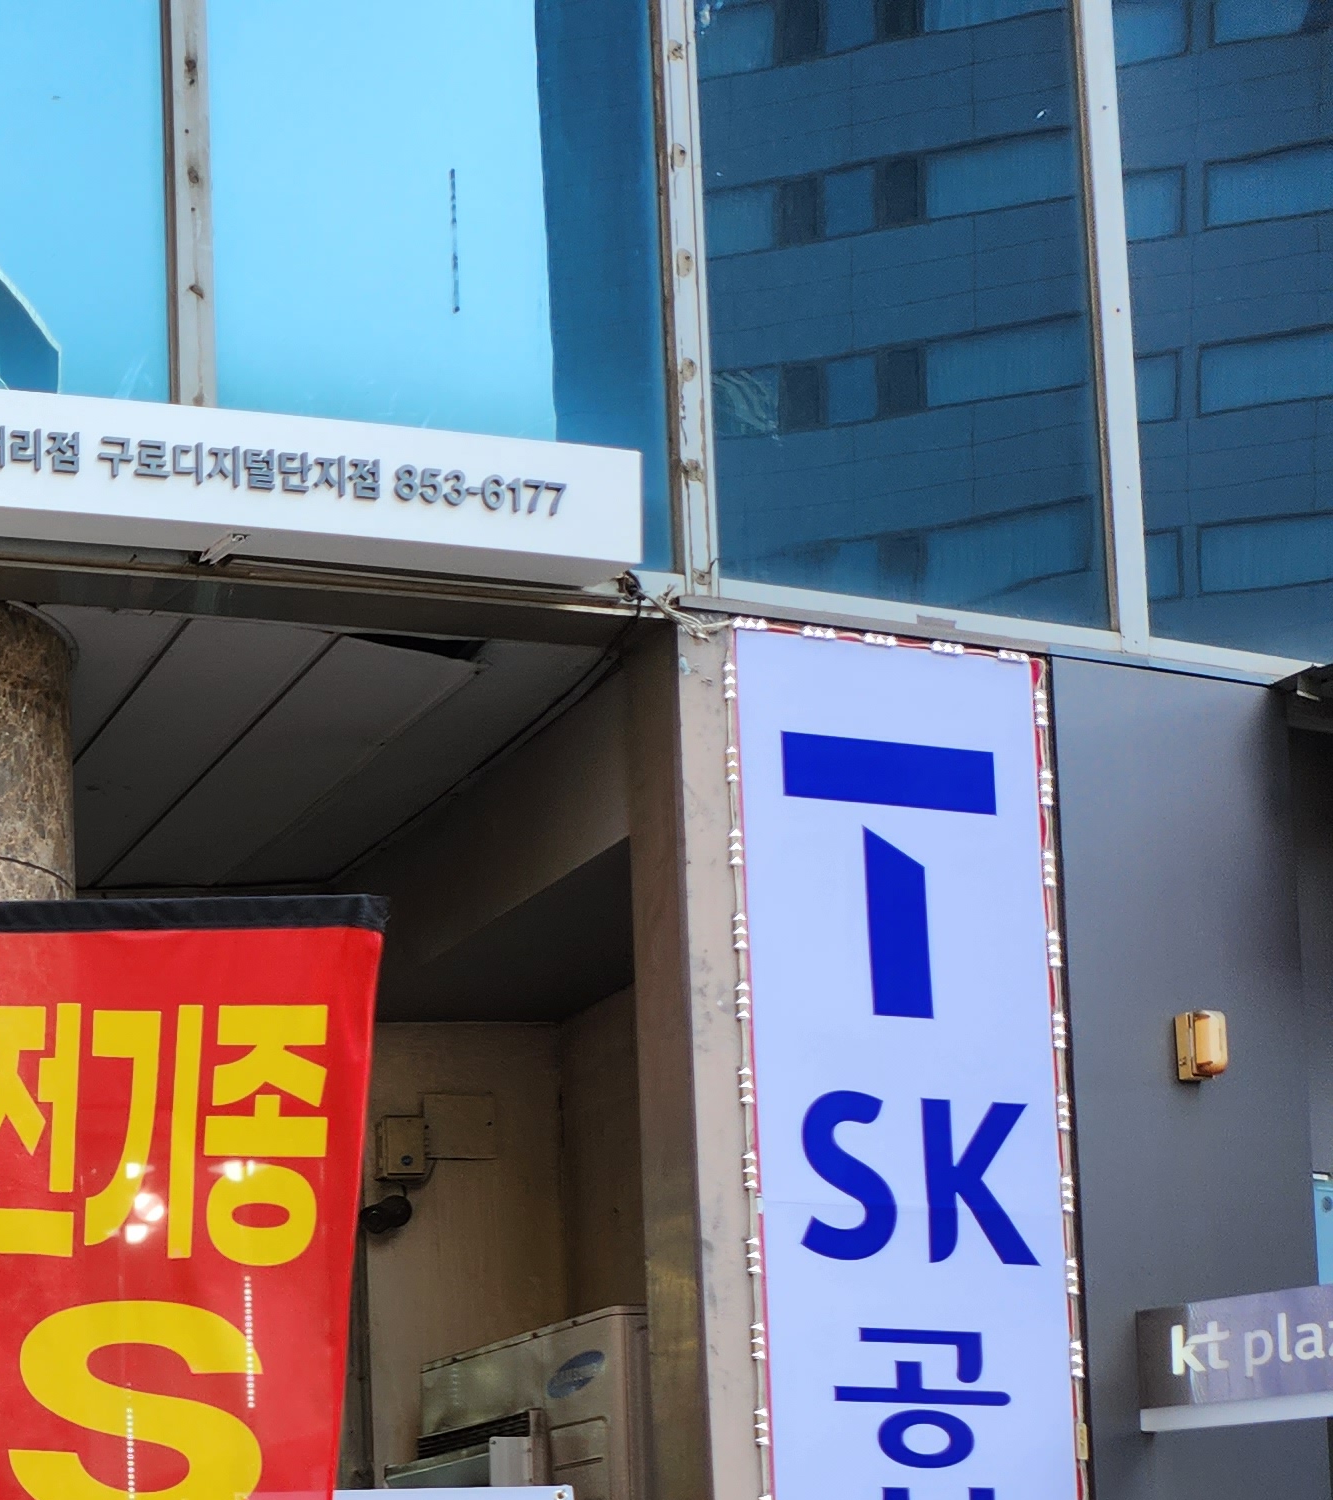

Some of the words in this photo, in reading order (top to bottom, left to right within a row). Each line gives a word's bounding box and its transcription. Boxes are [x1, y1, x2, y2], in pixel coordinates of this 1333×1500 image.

[98, 435, 383, 500] 구로디지털단지점
[393, 464, 567, 517] 853-6177
[800, 1089, 1041, 1267] SK
[1171, 1320, 1231, 1376] kt
